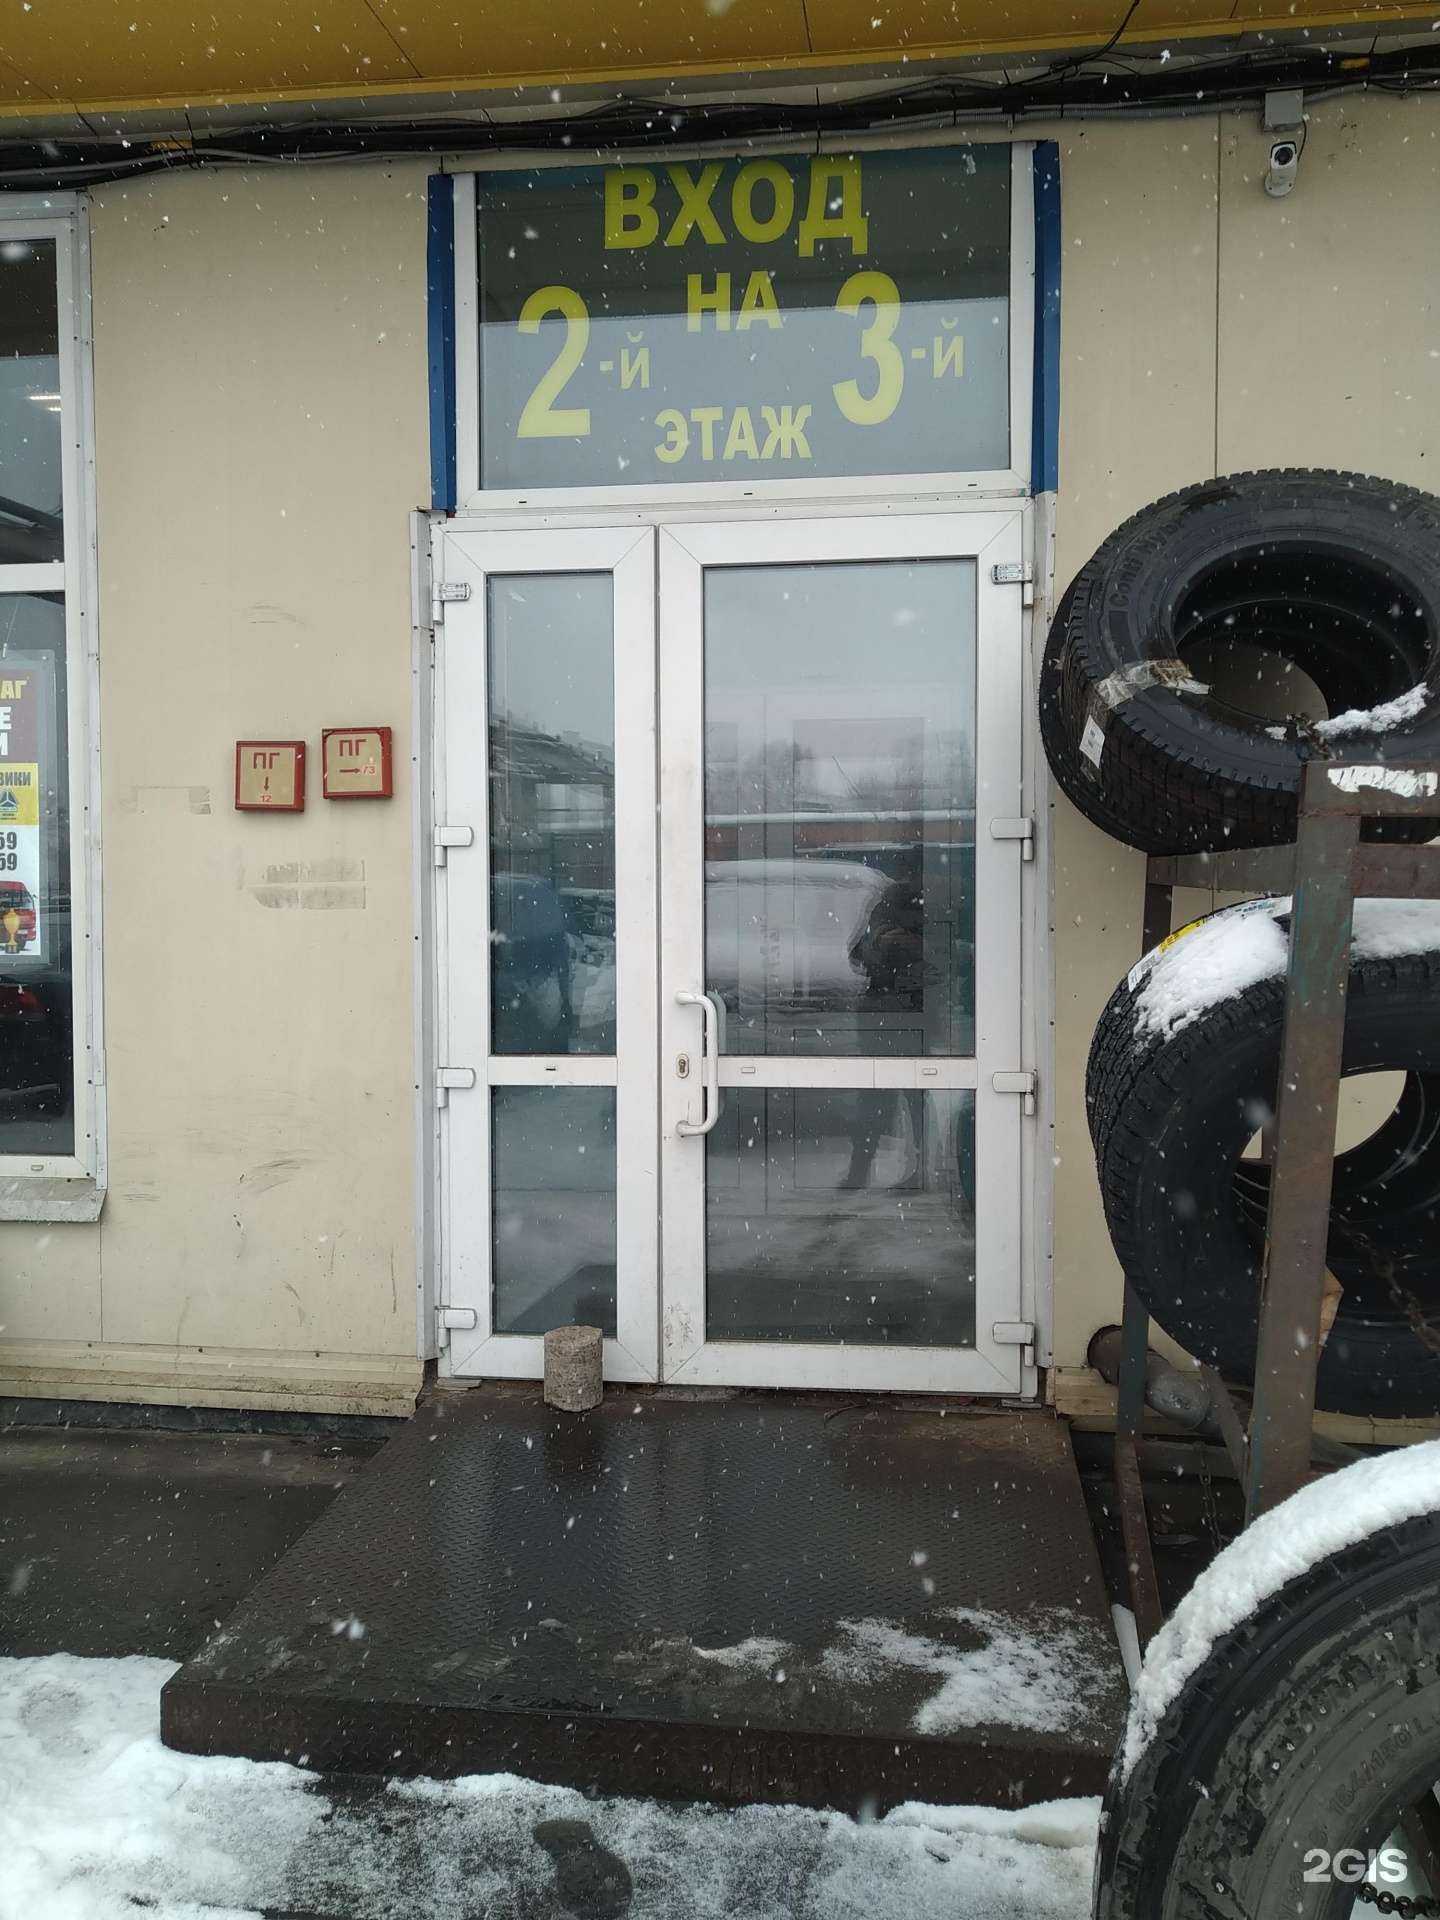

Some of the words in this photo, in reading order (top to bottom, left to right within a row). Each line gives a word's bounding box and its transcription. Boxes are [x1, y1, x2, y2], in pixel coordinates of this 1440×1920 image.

[604, 156, 869, 257] ВХОД
[687, 271, 783, 331] НА
[655, 404, 813, 464] ЭТАЖ
[253, 752, 280, 769] ПГ
[339, 739, 367, 756] ПГ
